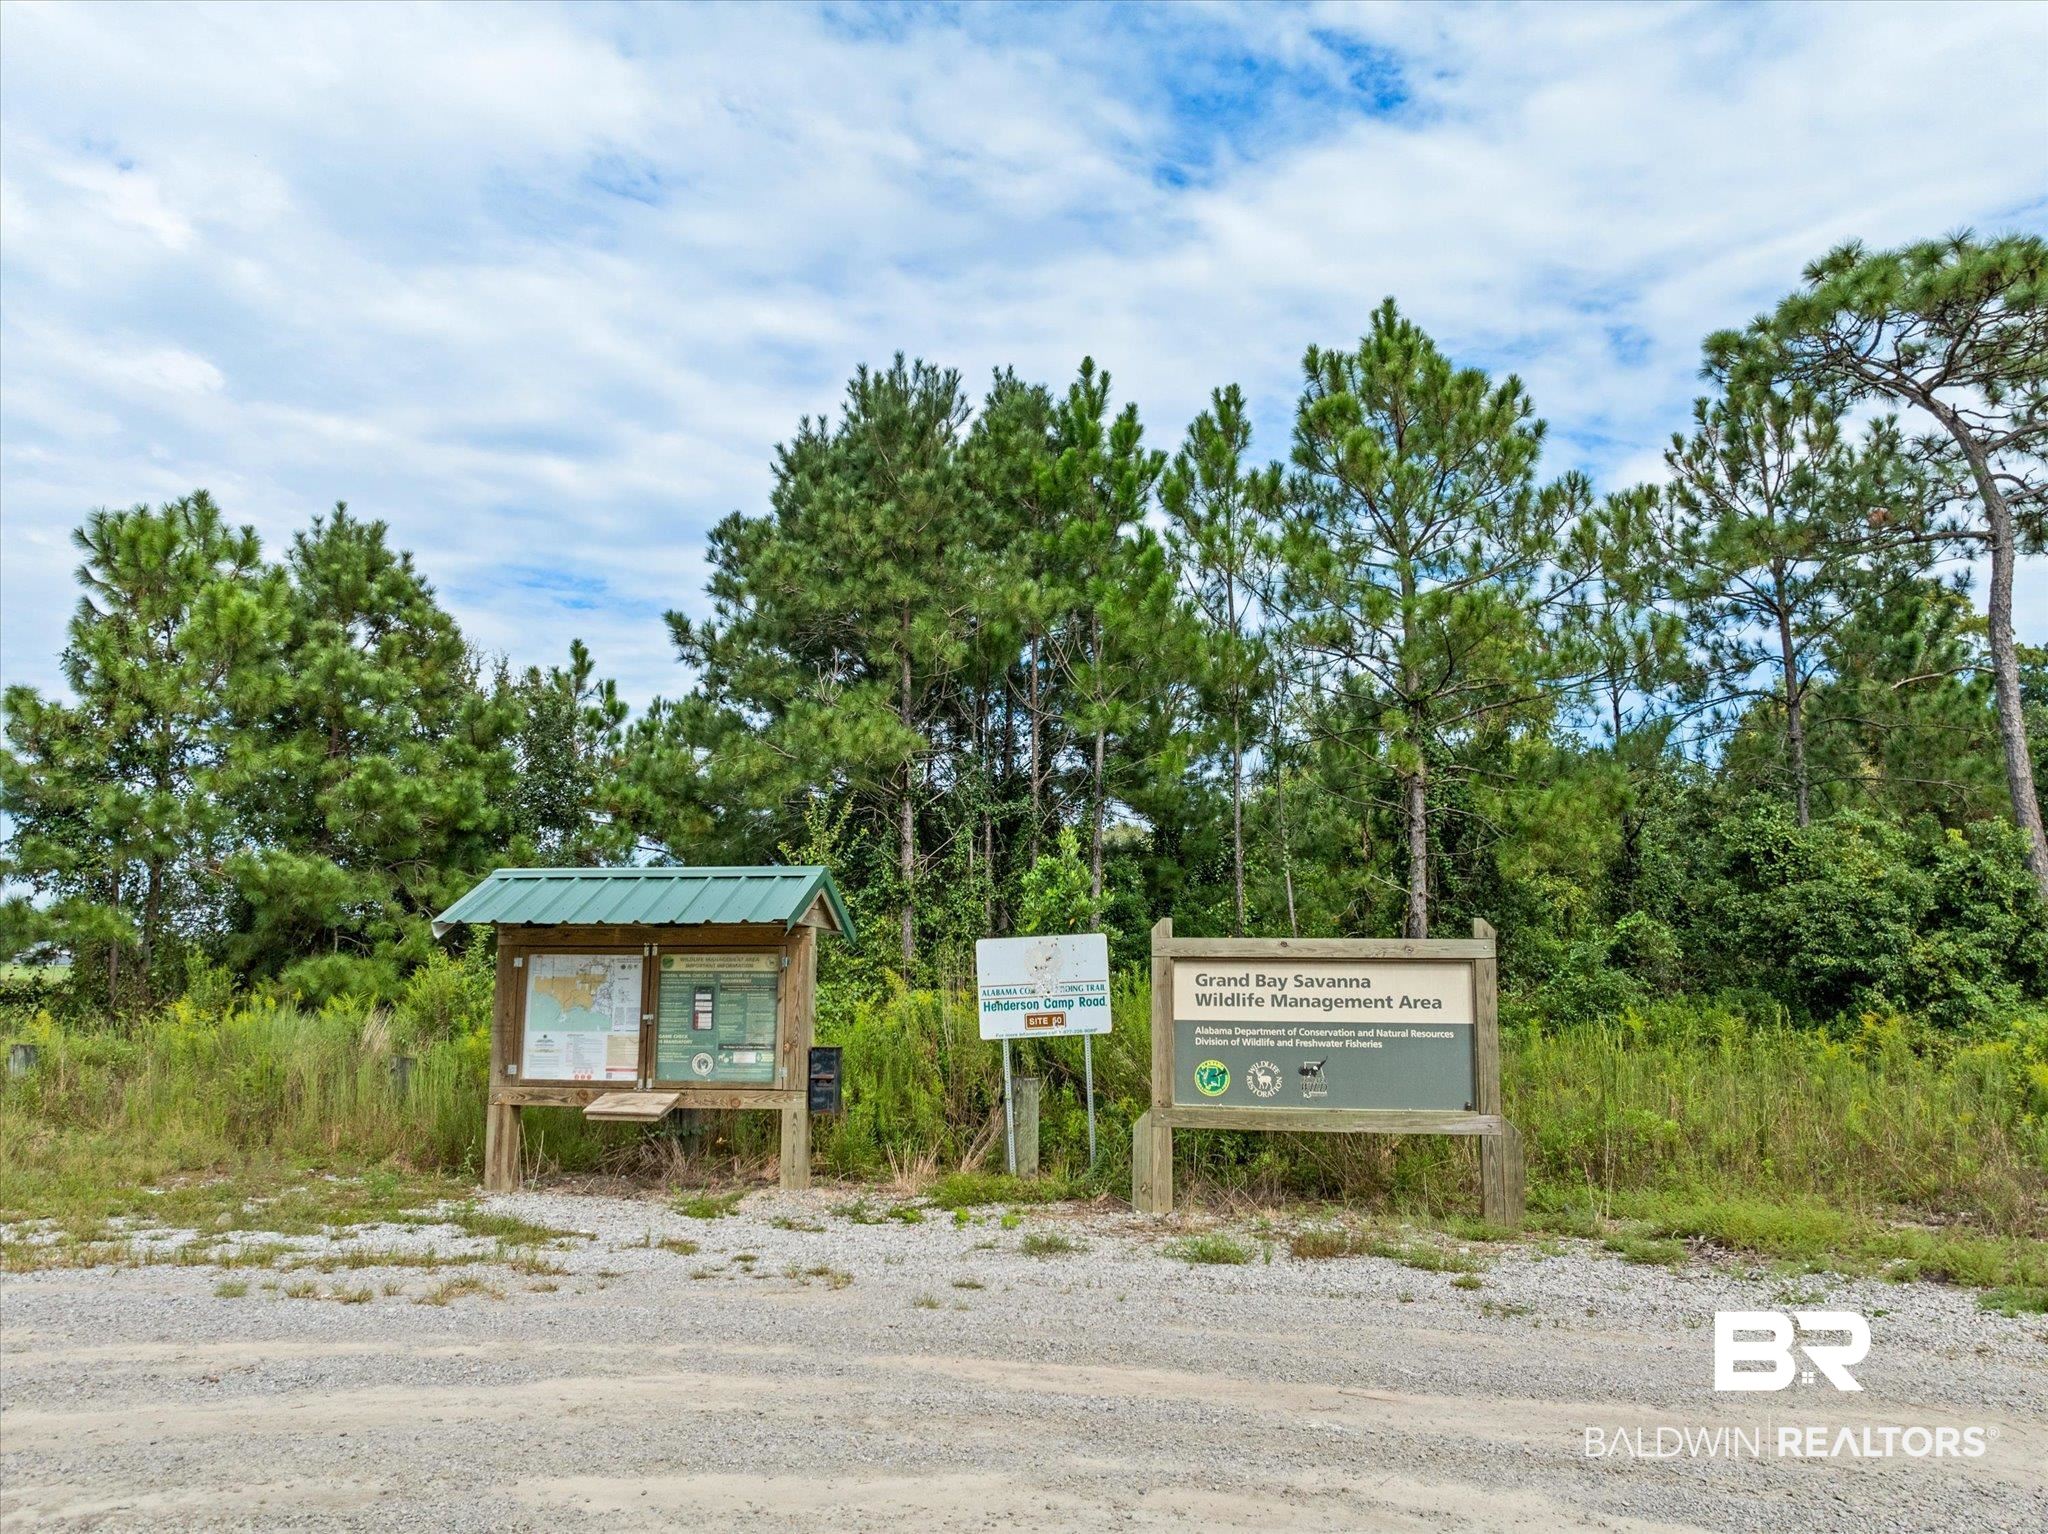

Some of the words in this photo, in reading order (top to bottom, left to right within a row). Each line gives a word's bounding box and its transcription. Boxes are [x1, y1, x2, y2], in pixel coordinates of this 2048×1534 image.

[982, 988, 1018, 997] ALABAMA
[1086, 983, 1105, 992] TRAIL
[1195, 973, 1250, 987] Grand
[1255, 974, 1288, 992] Bay
[1293, 974, 1371, 989] Savanna
[983, 1000, 1040, 1013] Henderson
[1043, 998, 1075, 1011] Camp
[1079, 996, 1106, 1008] Road
[1195, 993, 1265, 1008] Wildlife
[1270, 994, 1394, 1012] Management
[1398, 995, 1442, 1009] Area
[1029, 1016, 1048, 1026] SITE
[1195, 1026, 1233, 1036] Alabama
[1234, 1027, 1286, 1038] Department
[1287, 1027, 1297, 1037] of
[1298, 1028, 1356, 1038] Conservation
[1357, 1029, 1375, 1038] and
[1376, 1029, 1409, 1039] Natural
[1410, 1030, 1454, 1039] Resources
[1195, 1037, 1229, 1046] Division
[1230, 1037, 1240, 1046] of
[1242, 1038, 1275, 1047] Wildlife
[1276, 1038, 1294, 1047] and
[1295, 1039, 1344, 1048] Freshwater
[1345, 1040, 1383, 1049] Fisheries
[1248, 1060, 1280, 1075] WILDLIFE
[1246, 1076, 1283, 1098] RESTORATION
